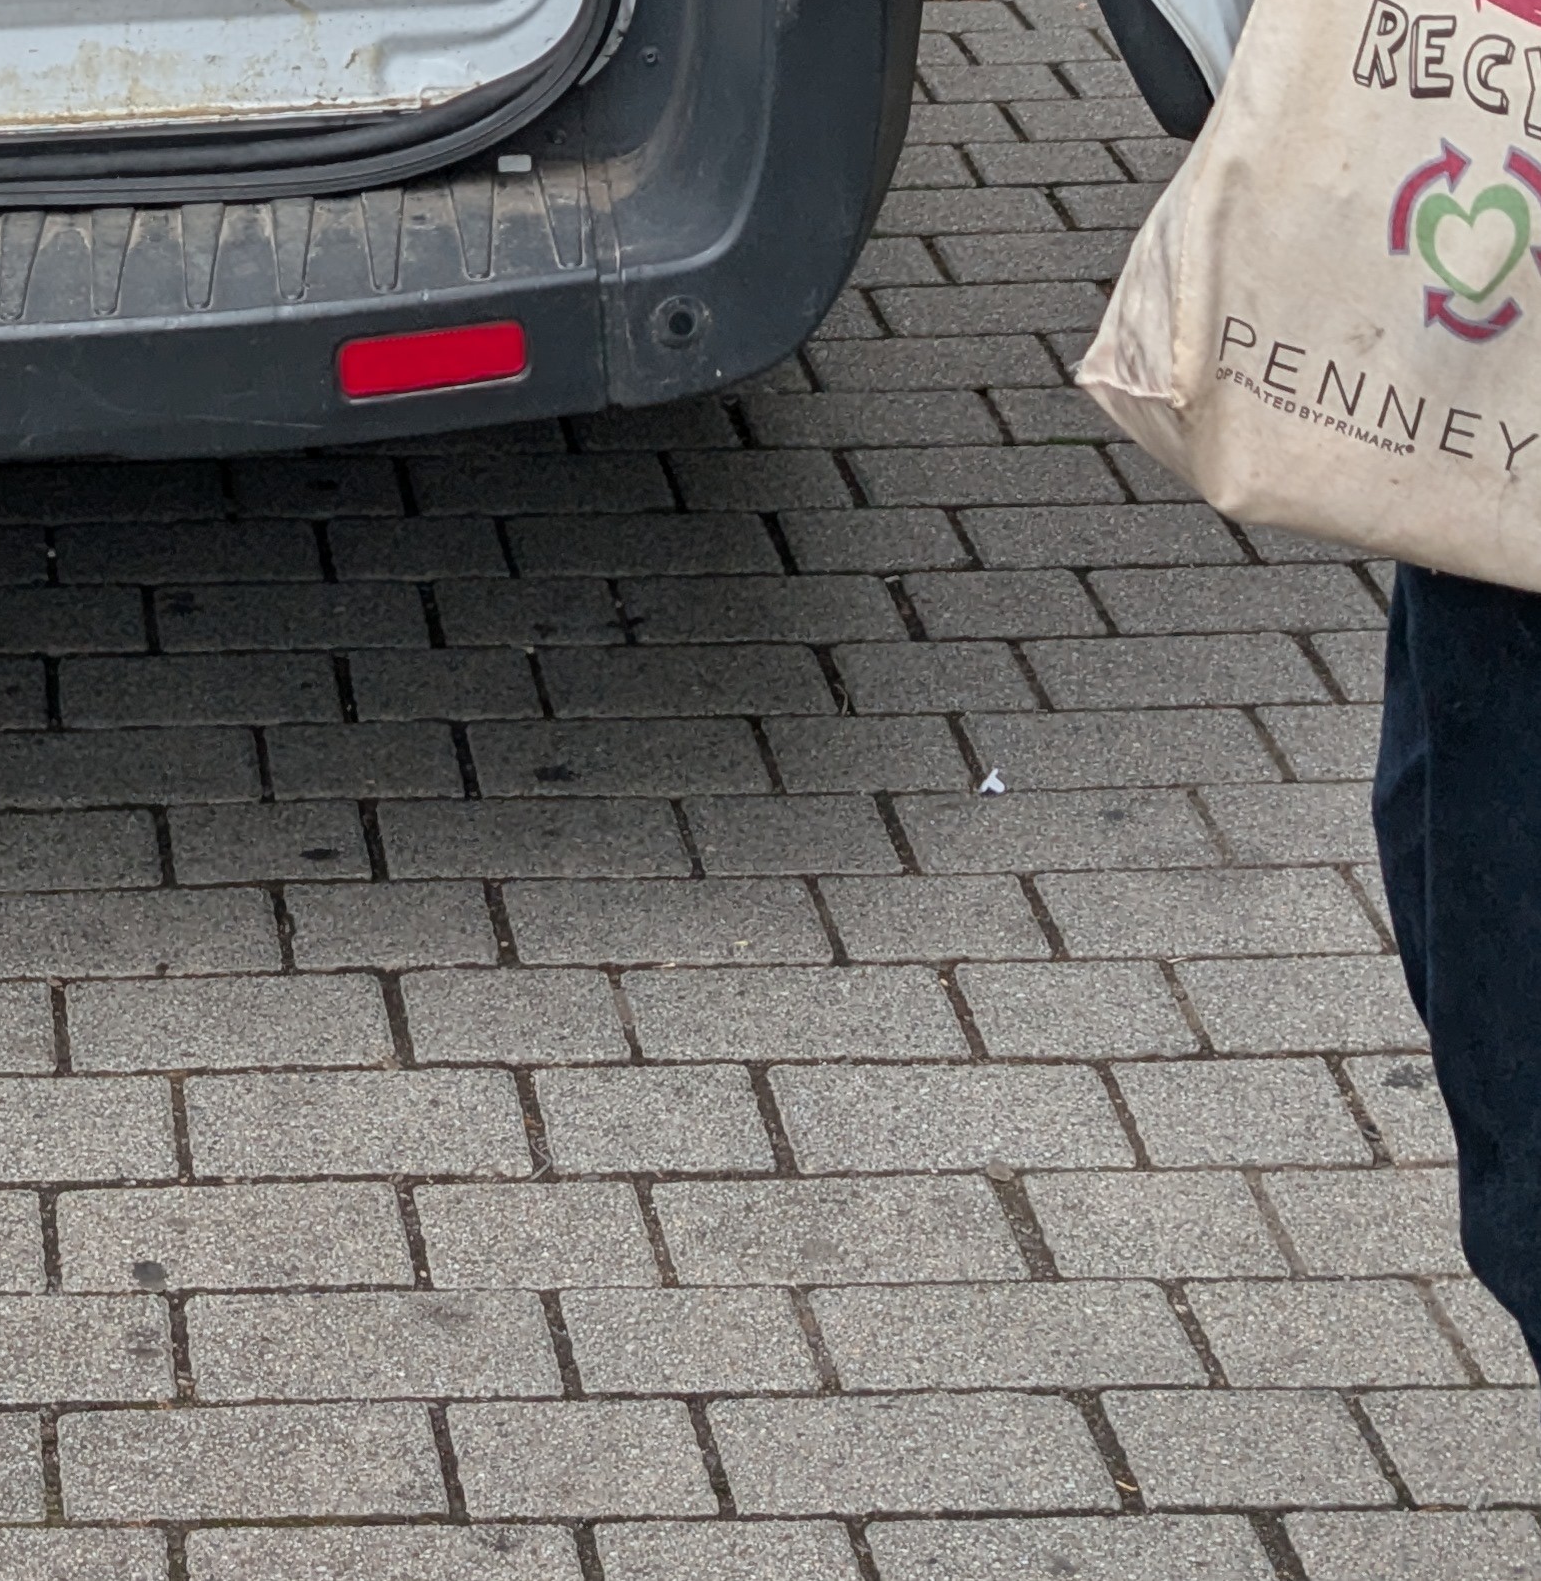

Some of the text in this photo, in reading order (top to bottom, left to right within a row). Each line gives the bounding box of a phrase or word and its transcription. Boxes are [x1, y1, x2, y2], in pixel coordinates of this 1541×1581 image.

[1215, 367, 1296, 414] OPERATED
[1299, 406, 1322, 424] BY
[1218, 315, 1539, 471] PENNEY
